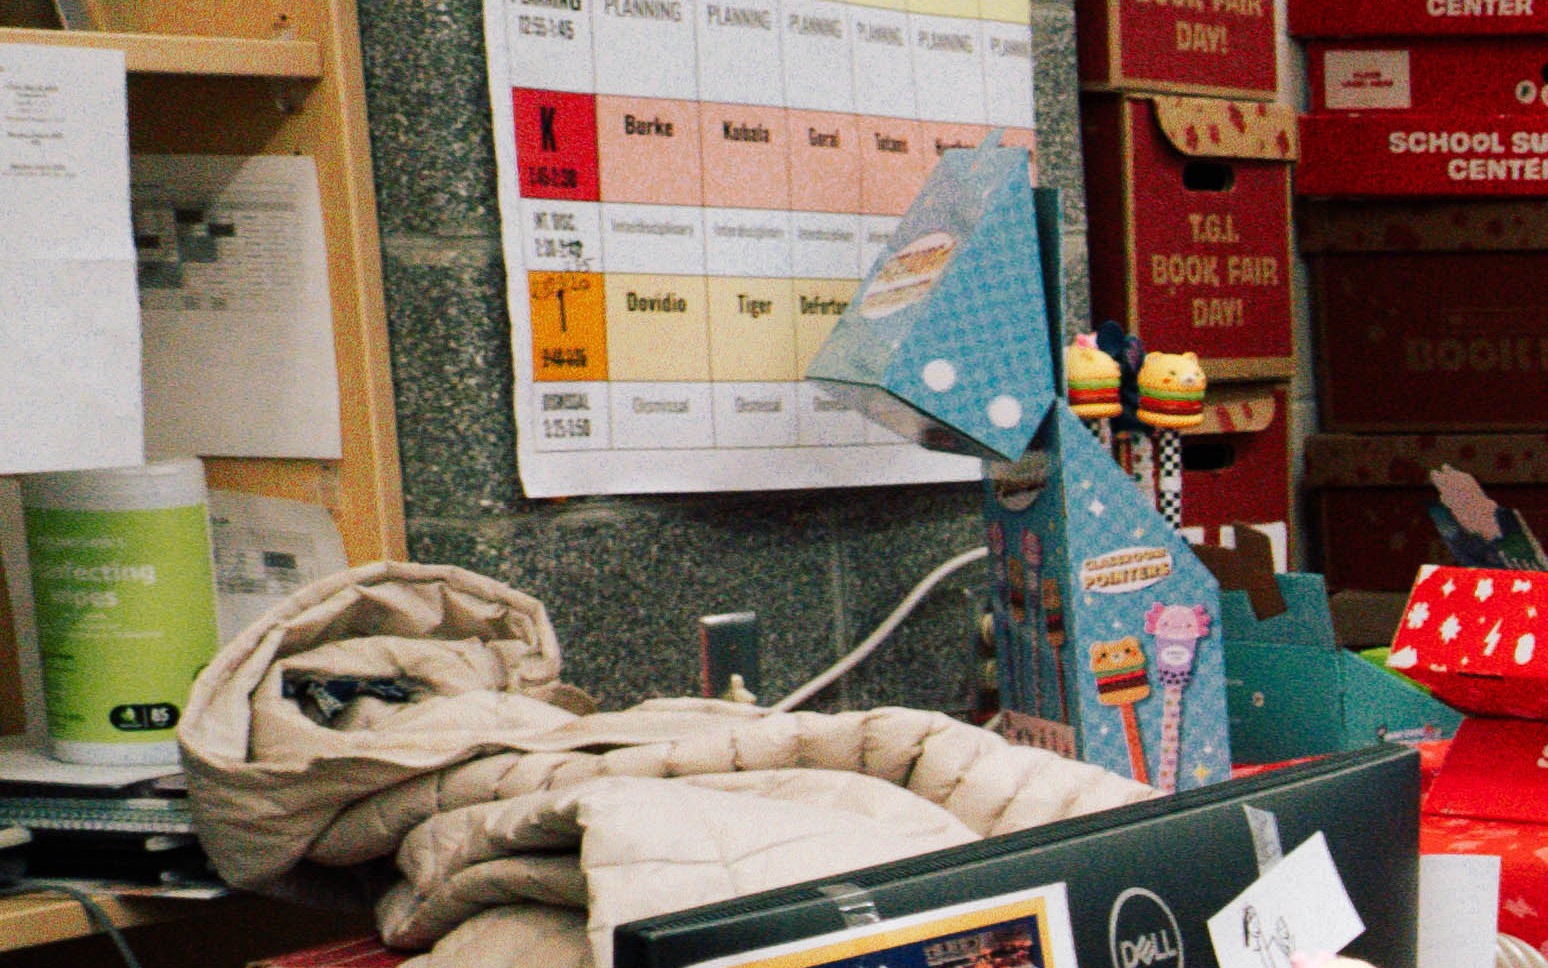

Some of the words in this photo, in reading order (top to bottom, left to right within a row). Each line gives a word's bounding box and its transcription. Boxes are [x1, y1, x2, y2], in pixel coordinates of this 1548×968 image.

[1175, 21, 1229, 54] DAY!
[540, 105, 557, 152] K
[1388, 131, 1506, 155] SCHOOL
[1151, 253, 1220, 287] BOOK
[1227, 256, 1280, 287] FAIR
[1191, 298, 1246, 328] DAY!
